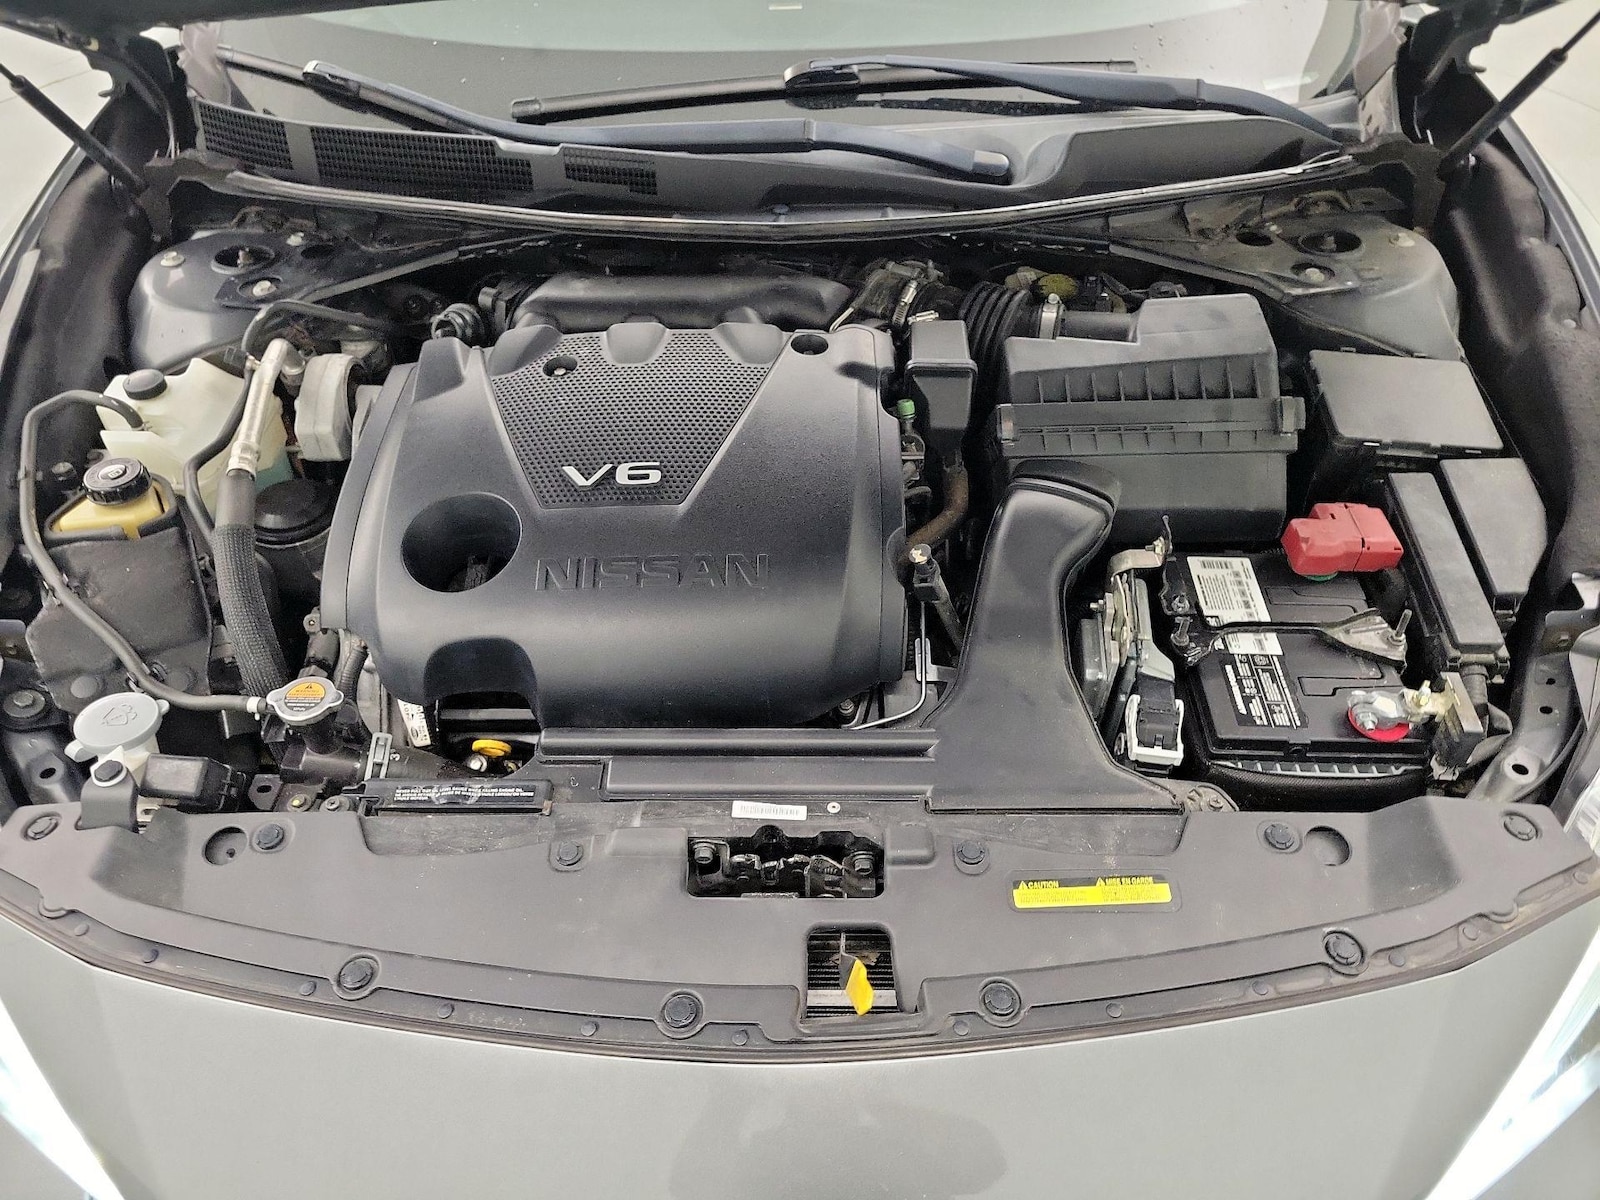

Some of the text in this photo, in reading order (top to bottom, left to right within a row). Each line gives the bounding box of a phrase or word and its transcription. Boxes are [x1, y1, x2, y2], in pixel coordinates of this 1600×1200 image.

[562, 461, 662, 487] V6
[534, 553, 770, 591] NISSAN
[1028, 880, 1060, 889] CAUTION
